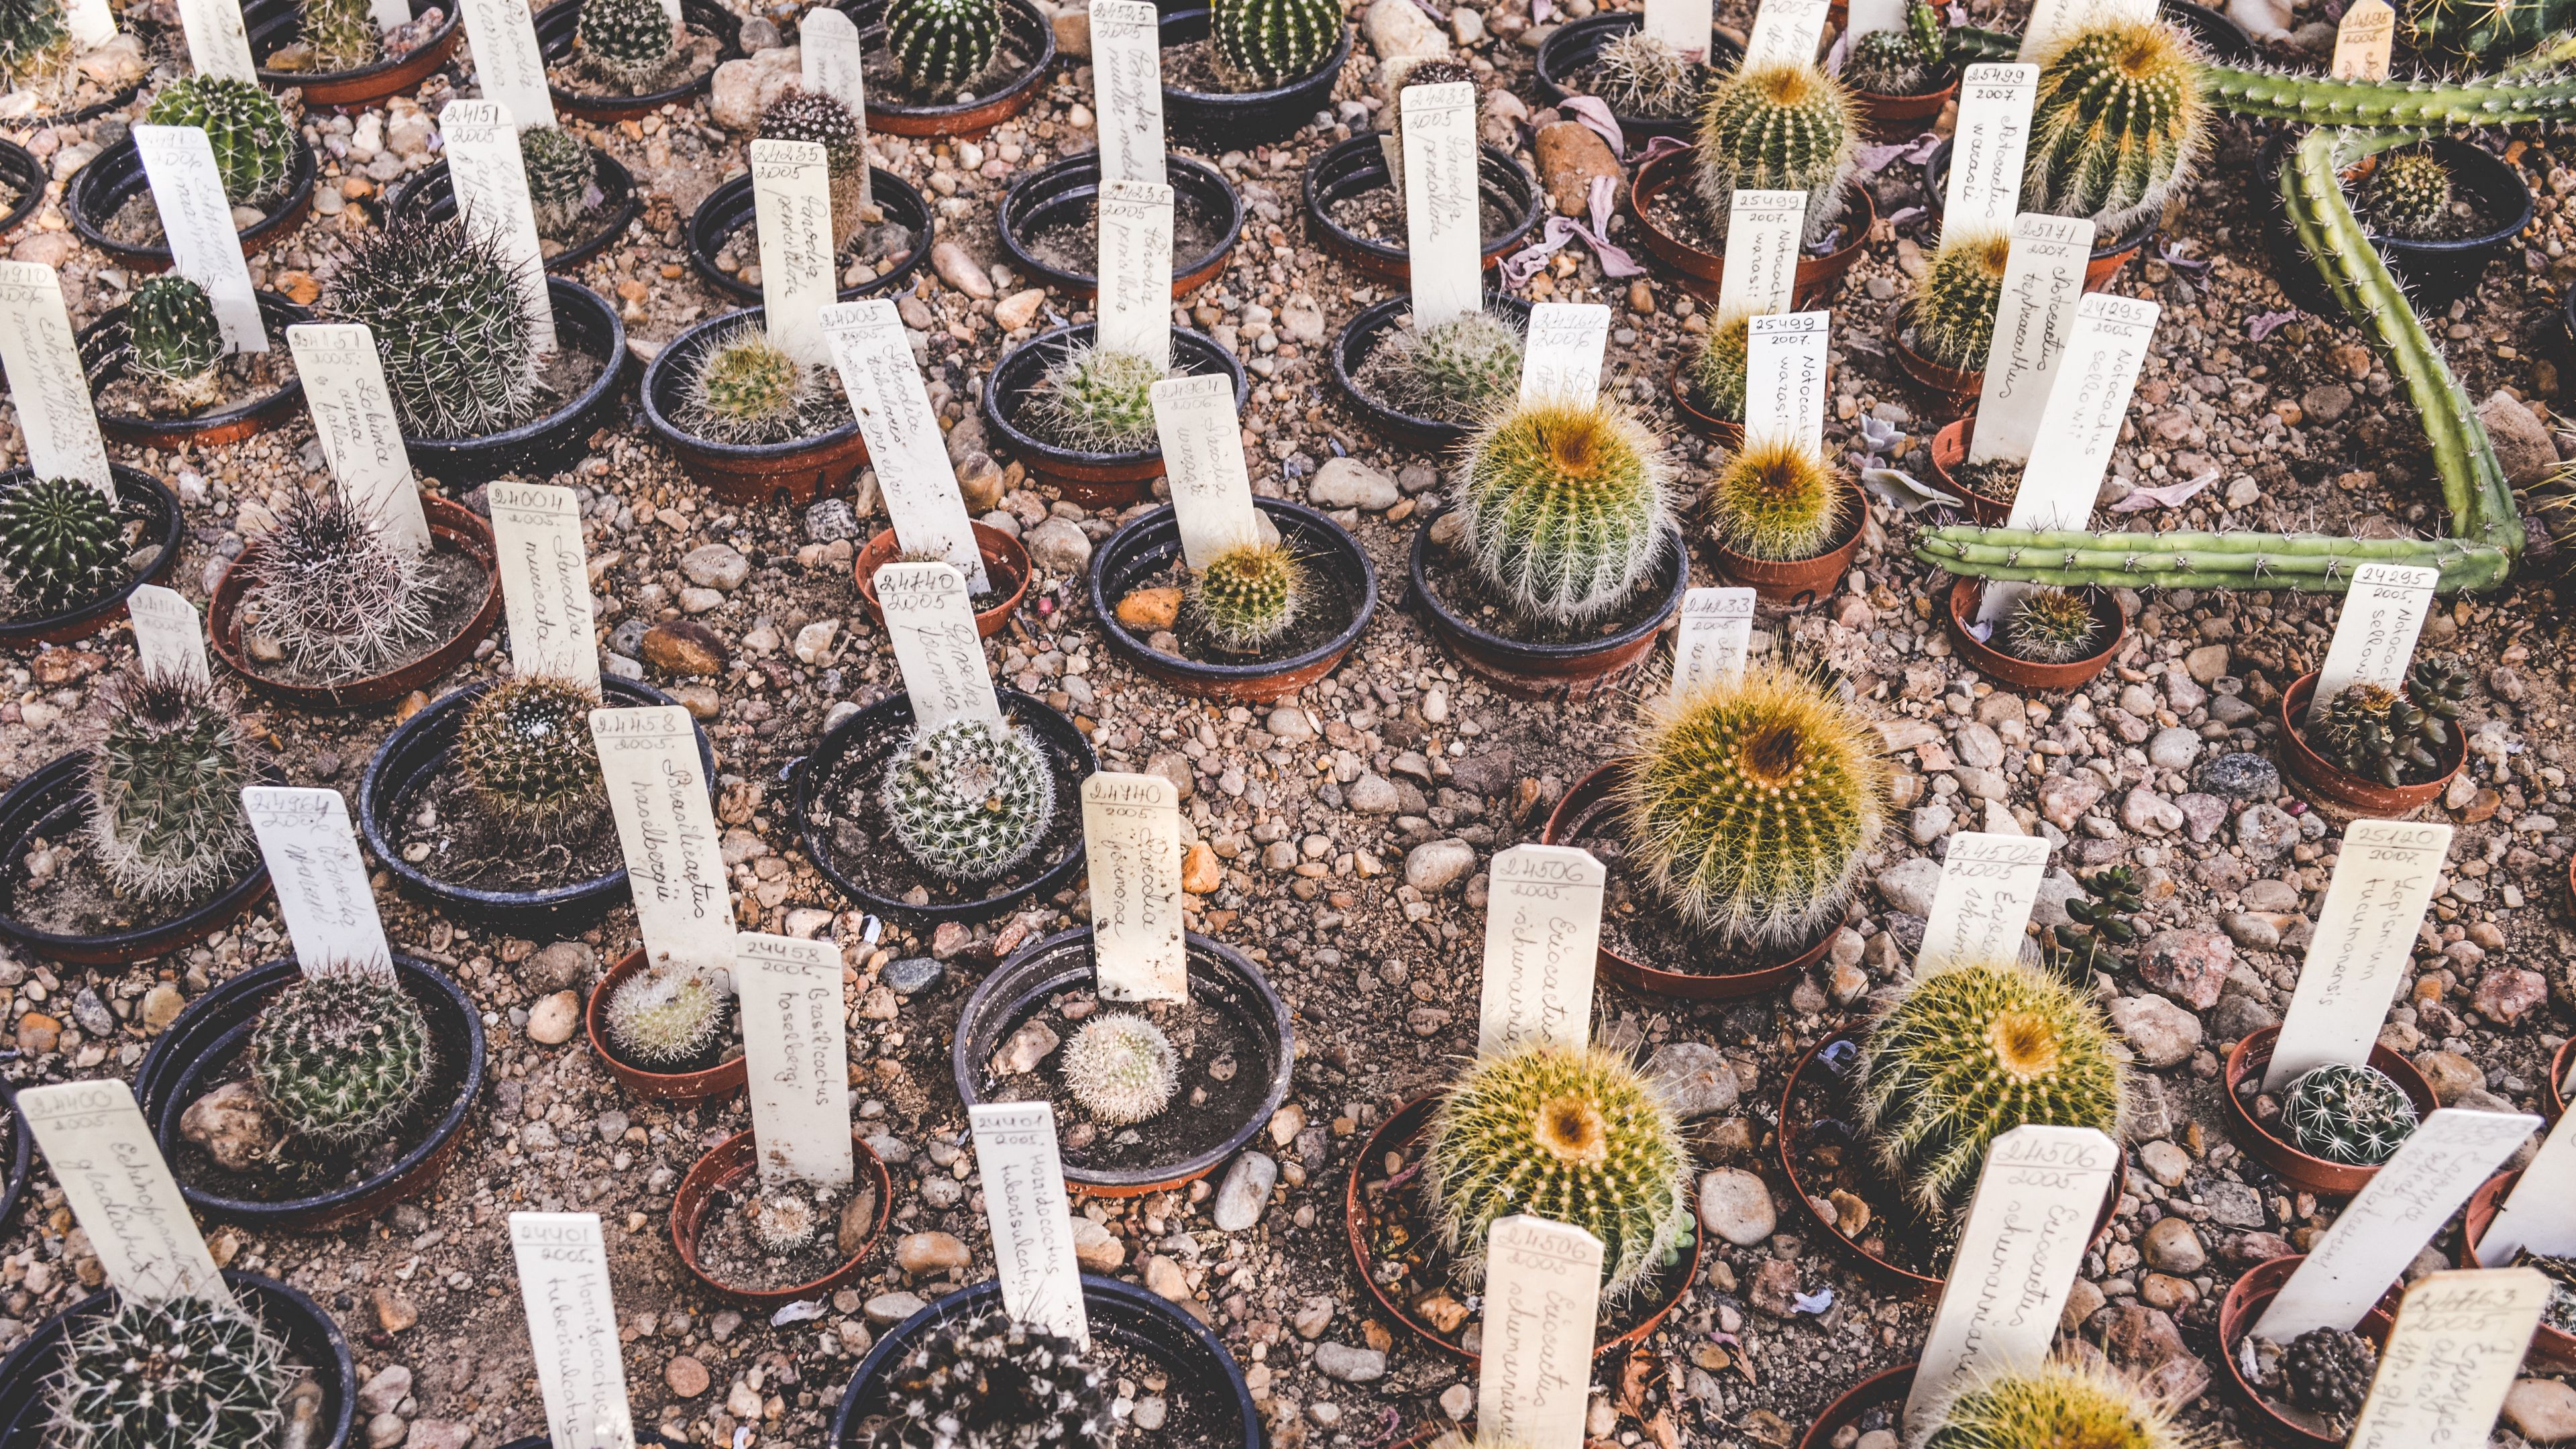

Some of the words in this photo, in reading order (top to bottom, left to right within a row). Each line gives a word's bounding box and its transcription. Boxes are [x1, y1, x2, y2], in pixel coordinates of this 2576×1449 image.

[1968, 69, 2025, 83] 25499
[1411, 87, 1472, 106] 24235
[445, 107, 498, 124] 24151
[1409, 109, 1461, 129] 2005
[453, 127, 499, 143] 2005
[754, 145, 825, 162] 24235
[1964, 123, 1984, 203] warasii
[755, 165, 810, 179] 2005
[1986, 115, 2017, 219] Notocactus
[1102, 204, 1156, 219] 2005
[1739, 195, 1799, 209] 25499
[2083, 300, 2147, 321] 24295
[1756, 317, 1815, 330] 25499
[2085, 348, 2133, 455] Notocactus
[339, 388, 367, 446] aurea
[492, 488, 562, 510] 24004
[2363, 568, 2430, 585] 24295
[526, 541, 556, 648] muricata
[553, 535, 586, 641] Parodia
[663, 759, 716, 919] Brasilicactus
[2359, 827, 2435, 846] 25120
[1949, 840, 2040, 862] 24506
[1500, 859, 1584, 882] 24506
[1948, 862, 2028, 879] 2005
[747, 941, 820, 963] 24458
[2318, 879, 2385, 1006] tucumanensis
[808, 987, 839, 1106] Brasilicactus
[978, 1115, 1042, 1129] 24401
[1996, 1140, 2098, 1168] 24506
[1028, 1151, 1065, 1275] Horridocactus
[521, 1226, 589, 1241] 24401
[1497, 1226, 1587, 1260] 24506
[2008, 1203, 2080, 1328] Eriocactus
[578, 1273, 616, 1414] Horridocactus
[1533, 1289, 1576, 1407] Eriocactus
